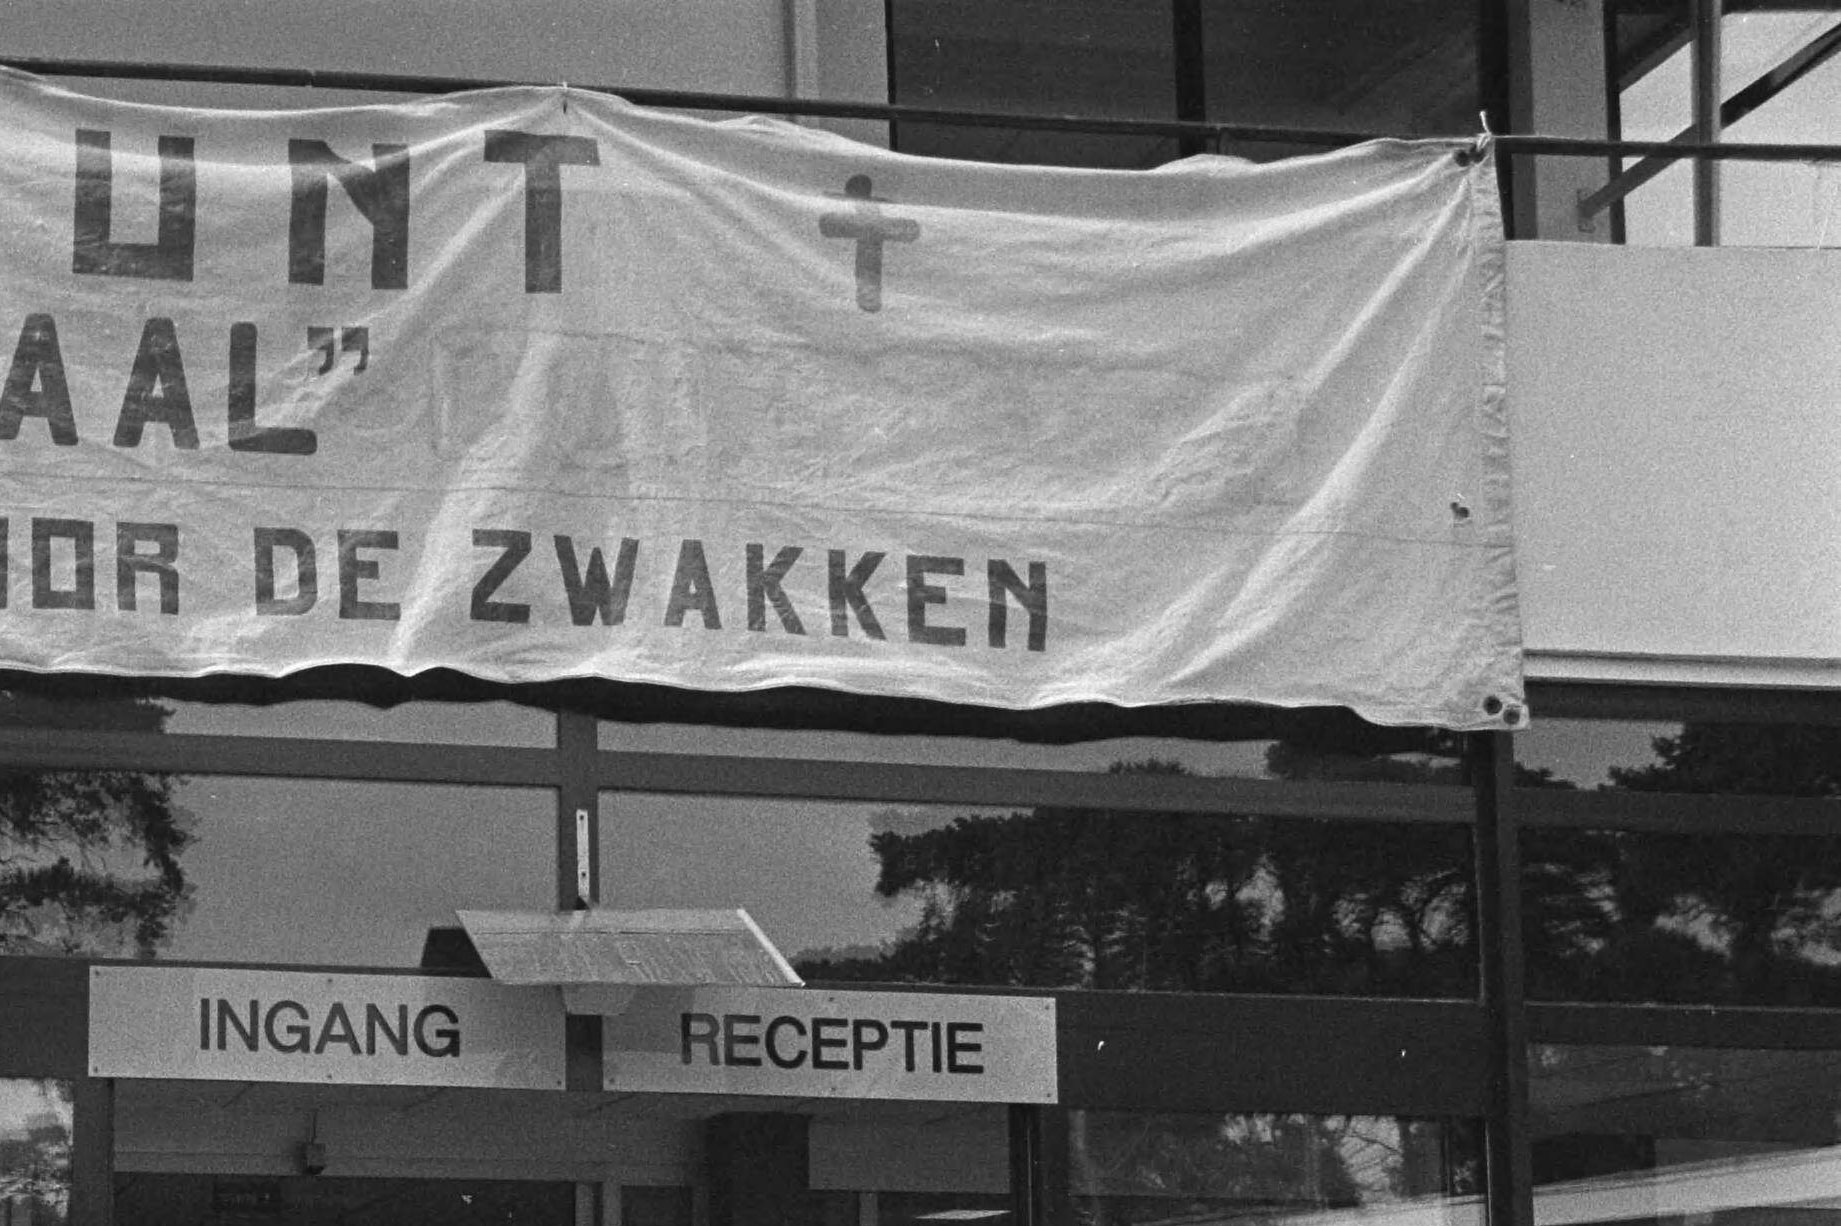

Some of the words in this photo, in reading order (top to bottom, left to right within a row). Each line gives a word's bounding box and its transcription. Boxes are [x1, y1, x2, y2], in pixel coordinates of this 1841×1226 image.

[257, 528, 401, 621] DE
[471, 528, 1049, 652] ZWAKKEN
[199, 998, 462, 1059] INGANG
[681, 1014, 985, 1074] RECEPTIE
